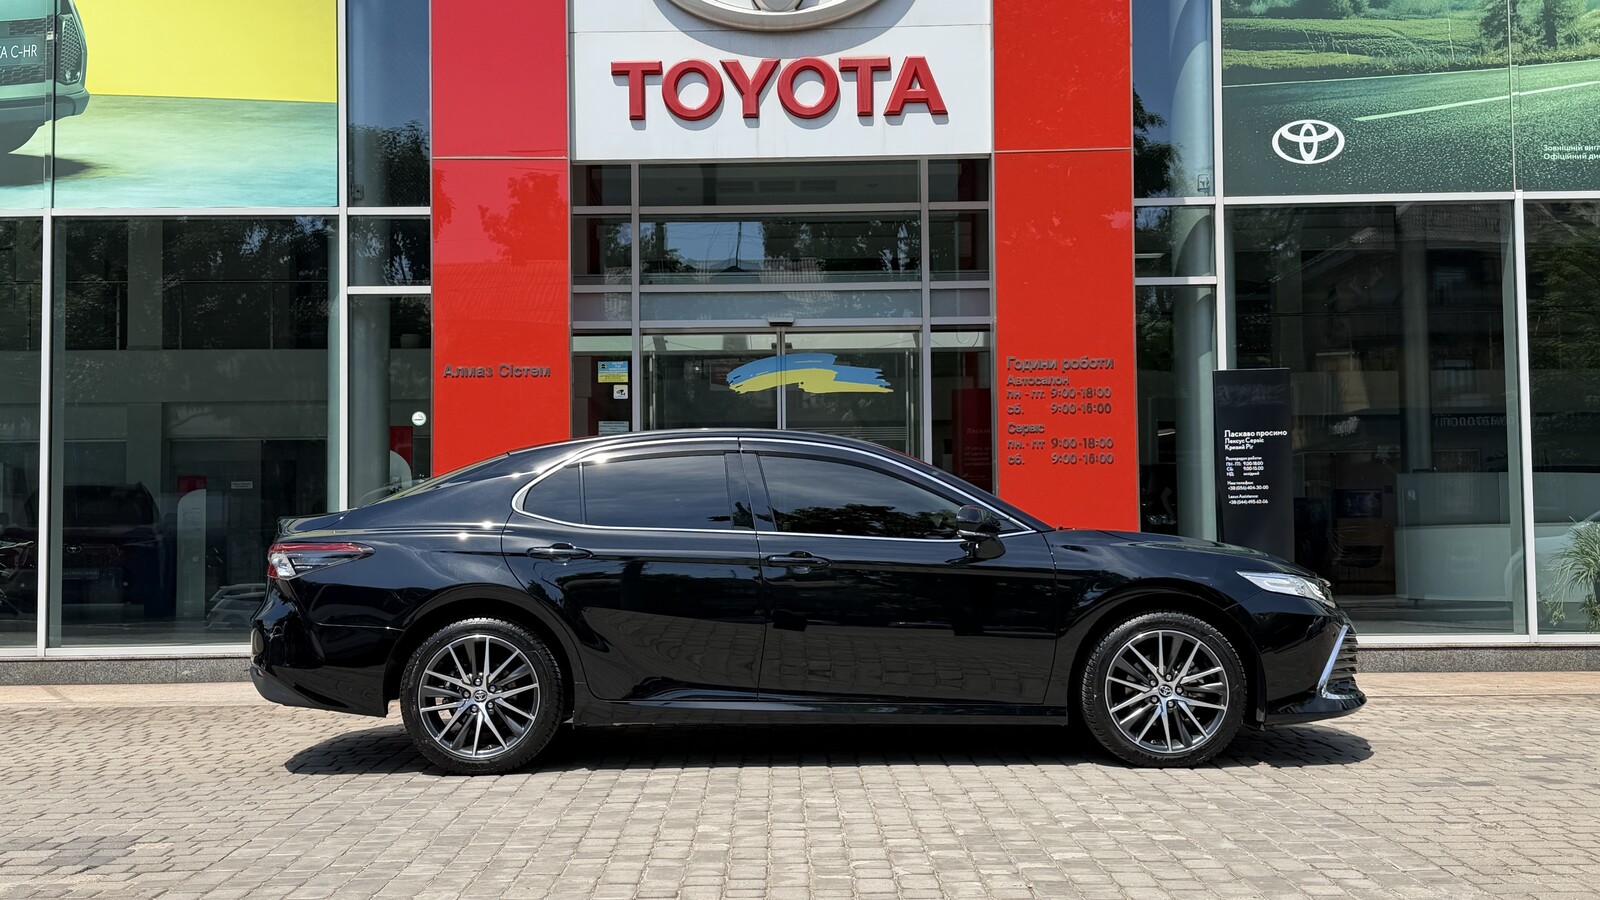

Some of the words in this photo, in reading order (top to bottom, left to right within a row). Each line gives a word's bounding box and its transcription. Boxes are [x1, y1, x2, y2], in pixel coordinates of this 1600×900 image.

[0, 45, 8, 59] A
[10, 44, 38, 59] C-HR
[610, 56, 949, 121] TOYOTA
[1543, 144, 1583, 152] Зовнішній
[1543, 152, 1587, 161] Офіційний
[443, 363, 494, 378] Алмаз
[498, 363, 551, 378] Сістем
[1006, 356, 1058, 372] Години
[1061, 356, 1115, 373] роботи
[1006, 375, 1070, 386] Автосалон
[1050, 387, 1112, 399] 9:00-18:00
[1006, 404, 1025, 415] сб.
[1007, 422, 1046, 436] Сервіс
[1224, 429, 1255, 437] Ласкаво
[1256, 430, 1287, 438] просимо
[1050, 437, 1115, 449] 9:00-18:00
[1007, 454, 1025, 465] сб.
